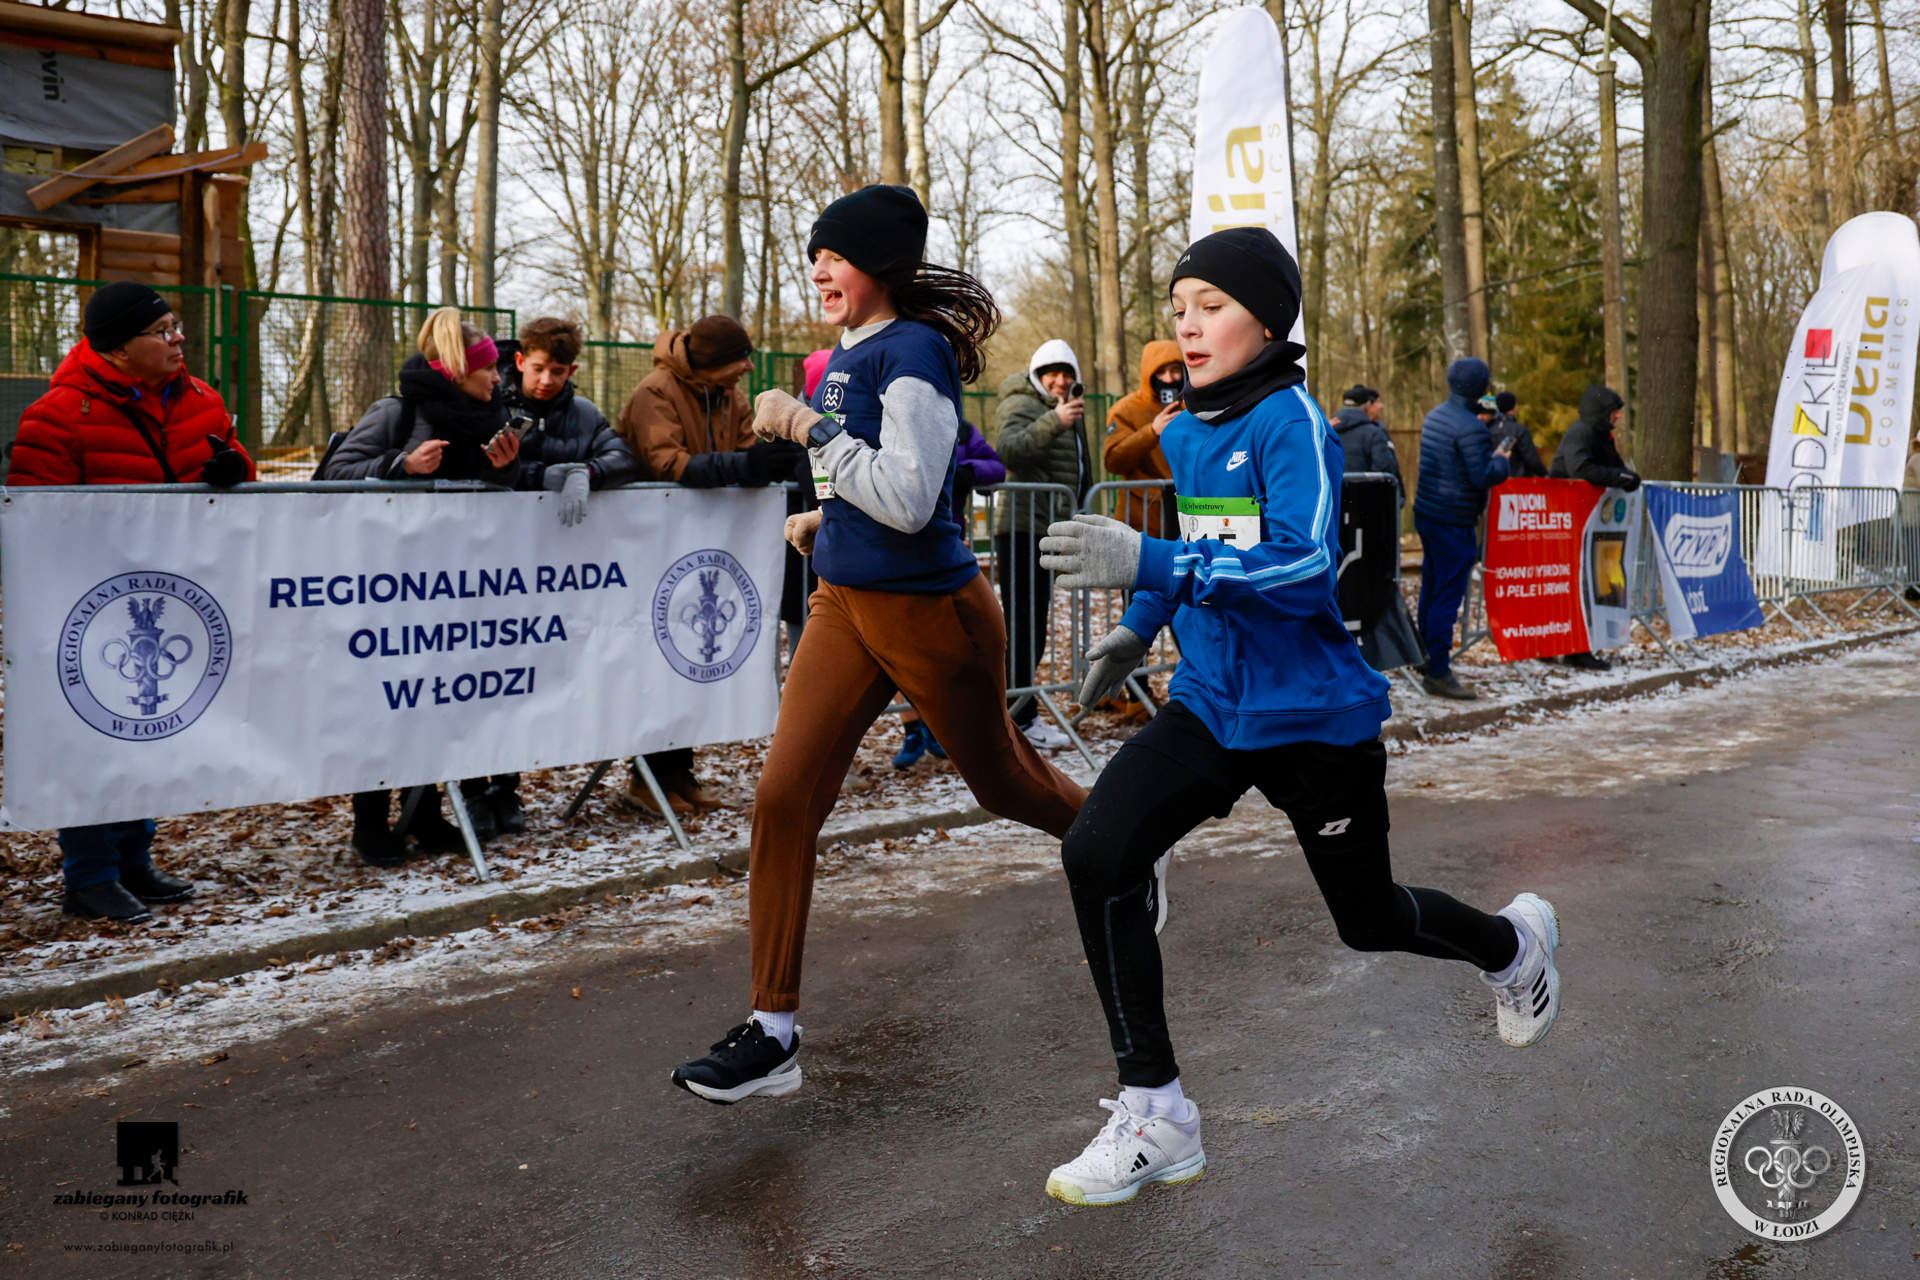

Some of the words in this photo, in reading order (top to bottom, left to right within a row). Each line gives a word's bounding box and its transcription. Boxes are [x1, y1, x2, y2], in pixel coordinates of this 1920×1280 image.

[1878, 298, 1909, 448] COSMETICS
[269, 566, 528, 608] REGIONALNA
[535, 562, 628, 593] RADA
[64, 584, 121, 687] REGIONALNA
[127, 577, 178, 593] RADA
[184, 588, 226, 678] OLIMPIJSKA
[348, 615, 568, 659] OLIMPIJSKA
[382, 678, 424, 710] W
[432, 666, 536, 705] ŁODZI
[112, 719, 128, 733] W
